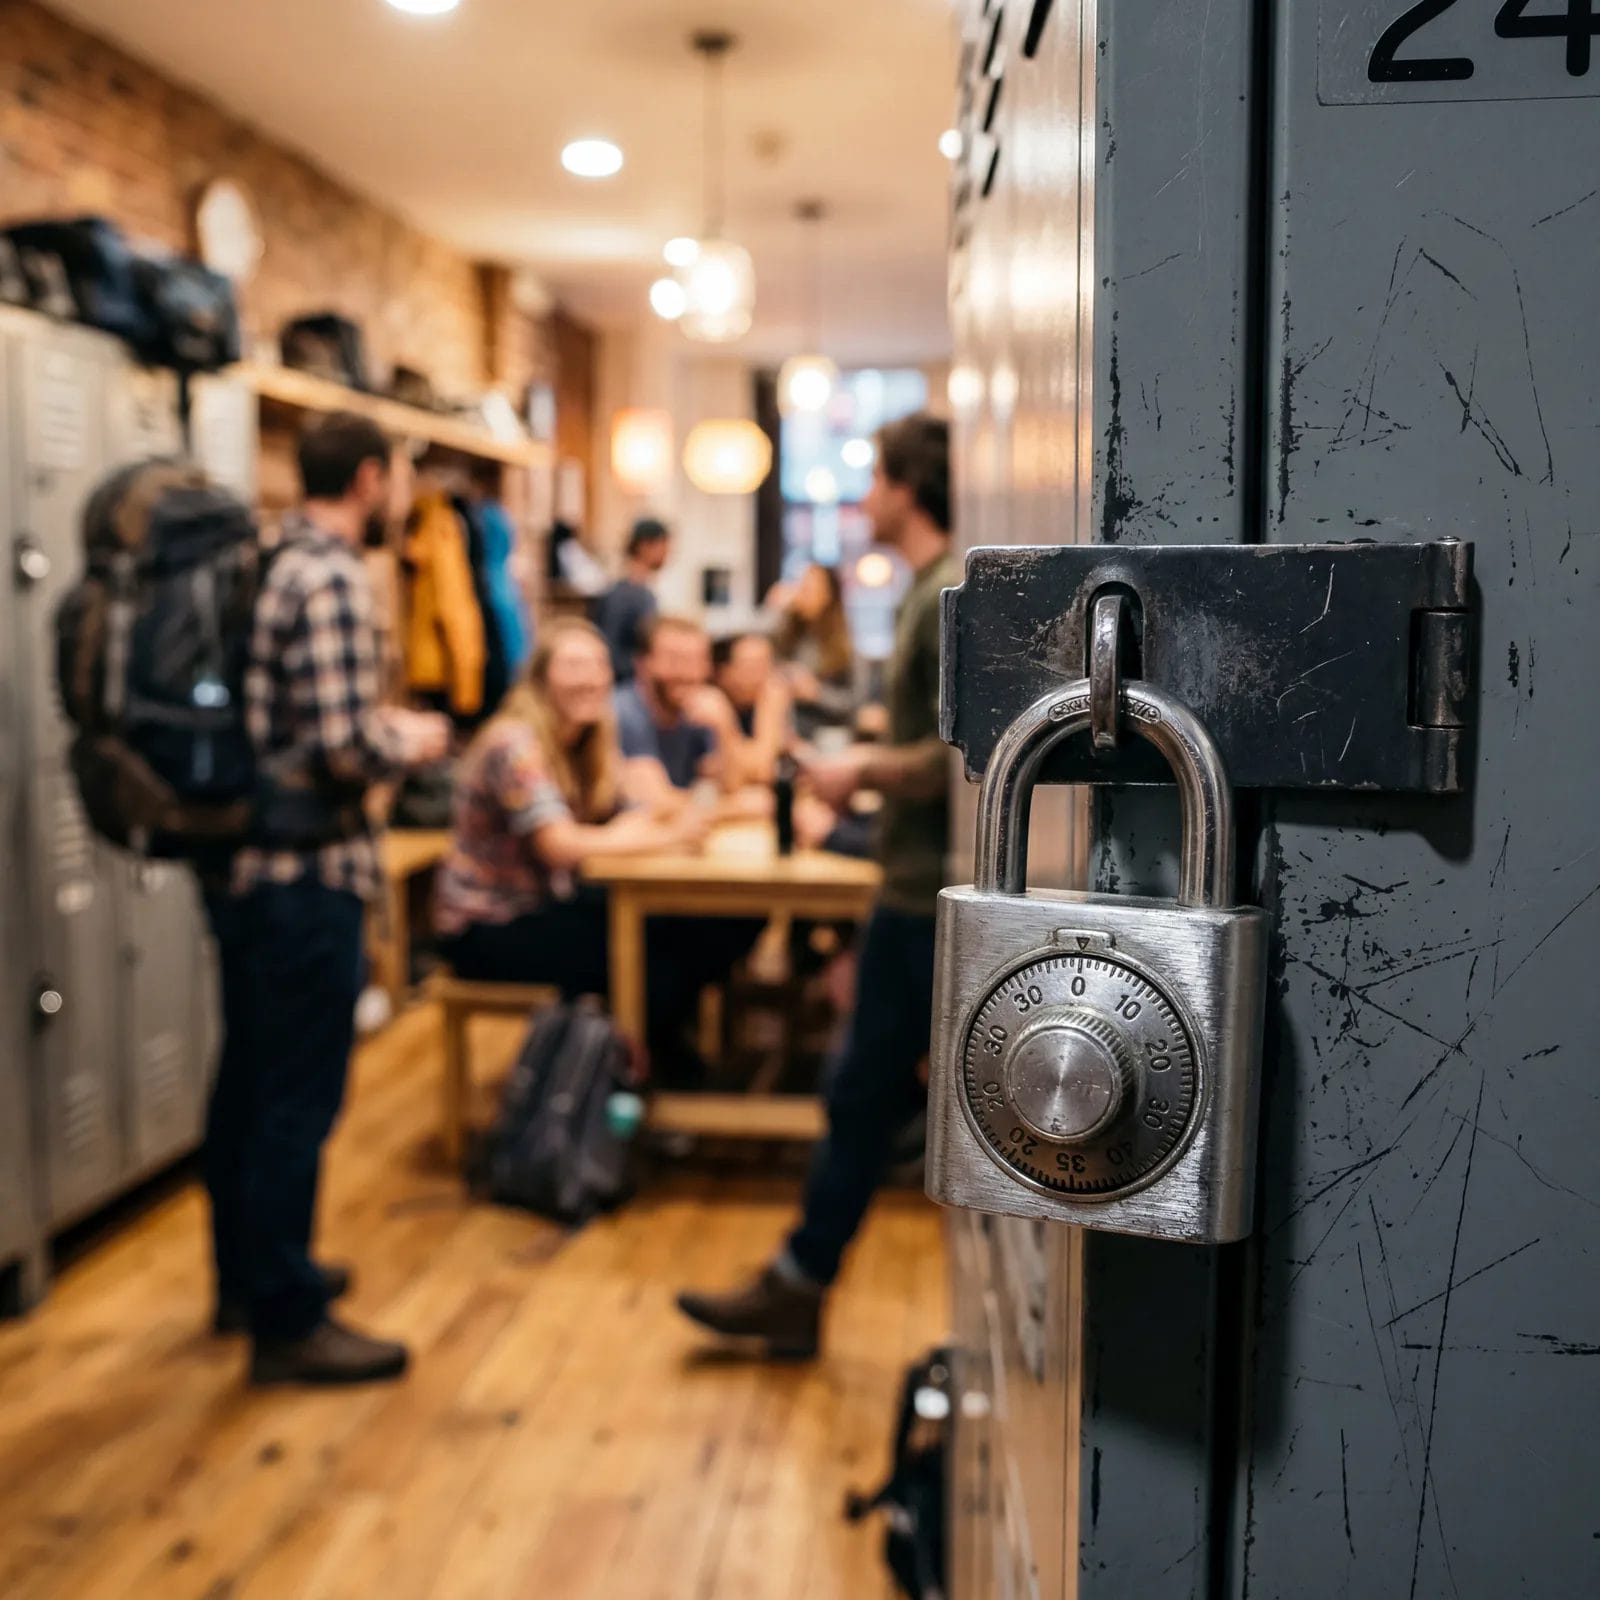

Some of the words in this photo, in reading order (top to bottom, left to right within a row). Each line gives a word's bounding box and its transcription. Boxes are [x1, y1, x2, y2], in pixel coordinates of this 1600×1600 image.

[1013, 985, 1044, 1014] 30
[1071, 976, 1086, 996] 0
[1115, 994, 1142, 1021] 10
[983, 1025, 1008, 1057] 30
[1145, 1039, 1172, 1072] 20
[983, 1081, 1004, 1112] 20
[1143, 1098, 1170, 1131] 30
[1009, 1126, 1039, 1155] 20
[1056, 1153, 1086, 1174] 35
